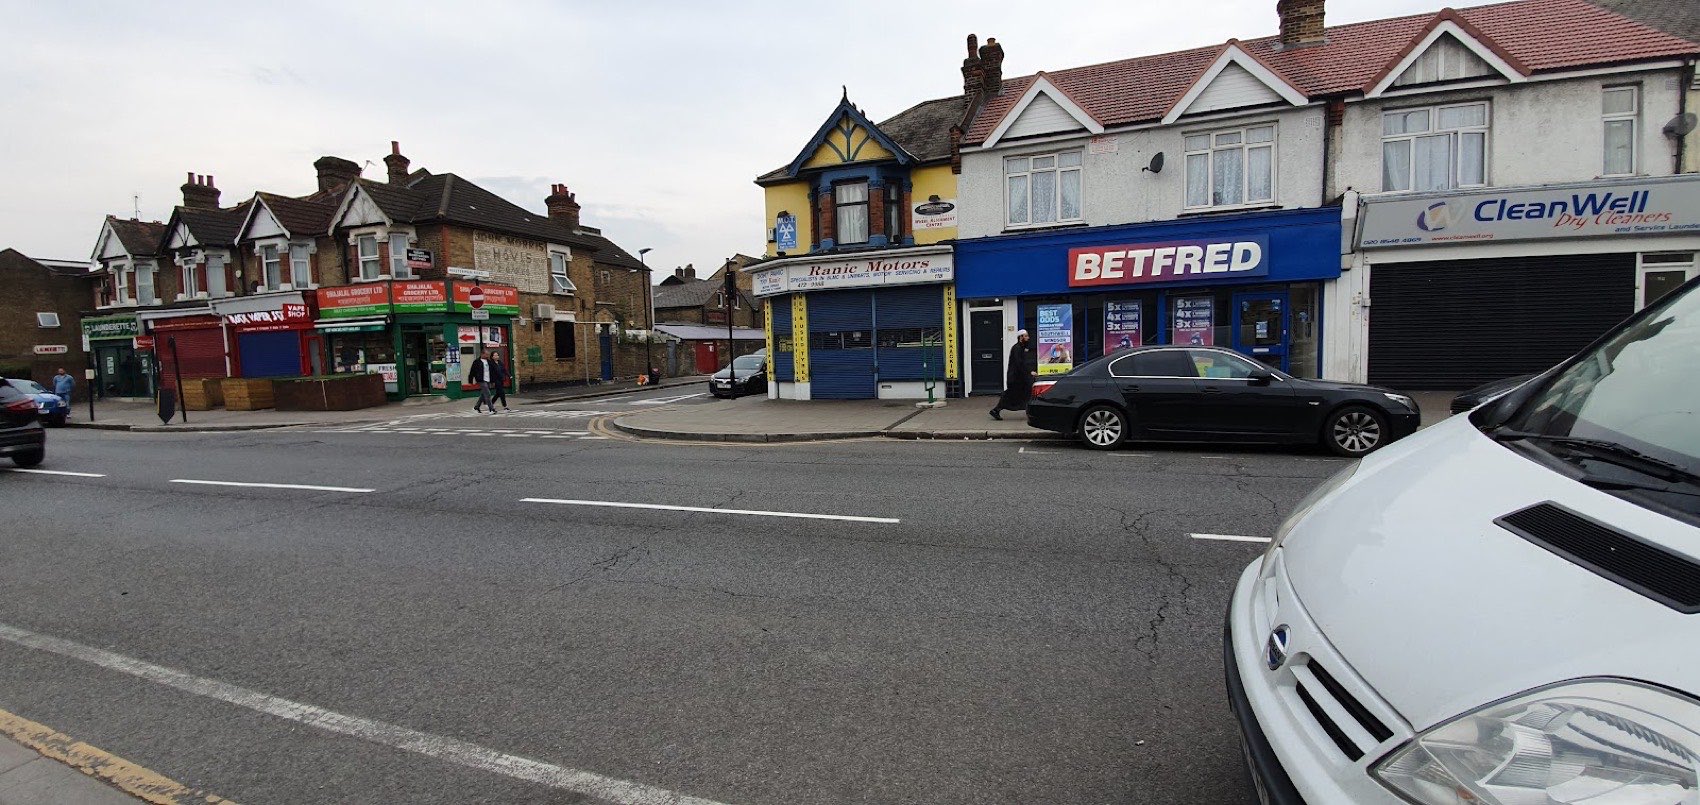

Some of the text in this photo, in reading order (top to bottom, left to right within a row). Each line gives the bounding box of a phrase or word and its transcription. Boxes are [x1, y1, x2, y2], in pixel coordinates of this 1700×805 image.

[1474, 190, 1650, 222] CleanWell
[1554, 210, 1672, 231] Dry Cleaners
[1074, 241, 1262, 281] BETFRED
[808, 259, 930, 276] Ranic Motors
[351, 287, 373, 296] GROCERY
[373, 286, 383, 294] LTD
[1107, 302, 1121, 311] 5x
[1176, 298, 1192, 308] 5x
[1039, 309, 1058, 317] BEST
[1039, 316, 1060, 324] ODDS
[1175, 319, 1191, 328] 3x
[91, 322, 131, 331] LAUNDERETTE
[1106, 321, 1121, 331] 3x
